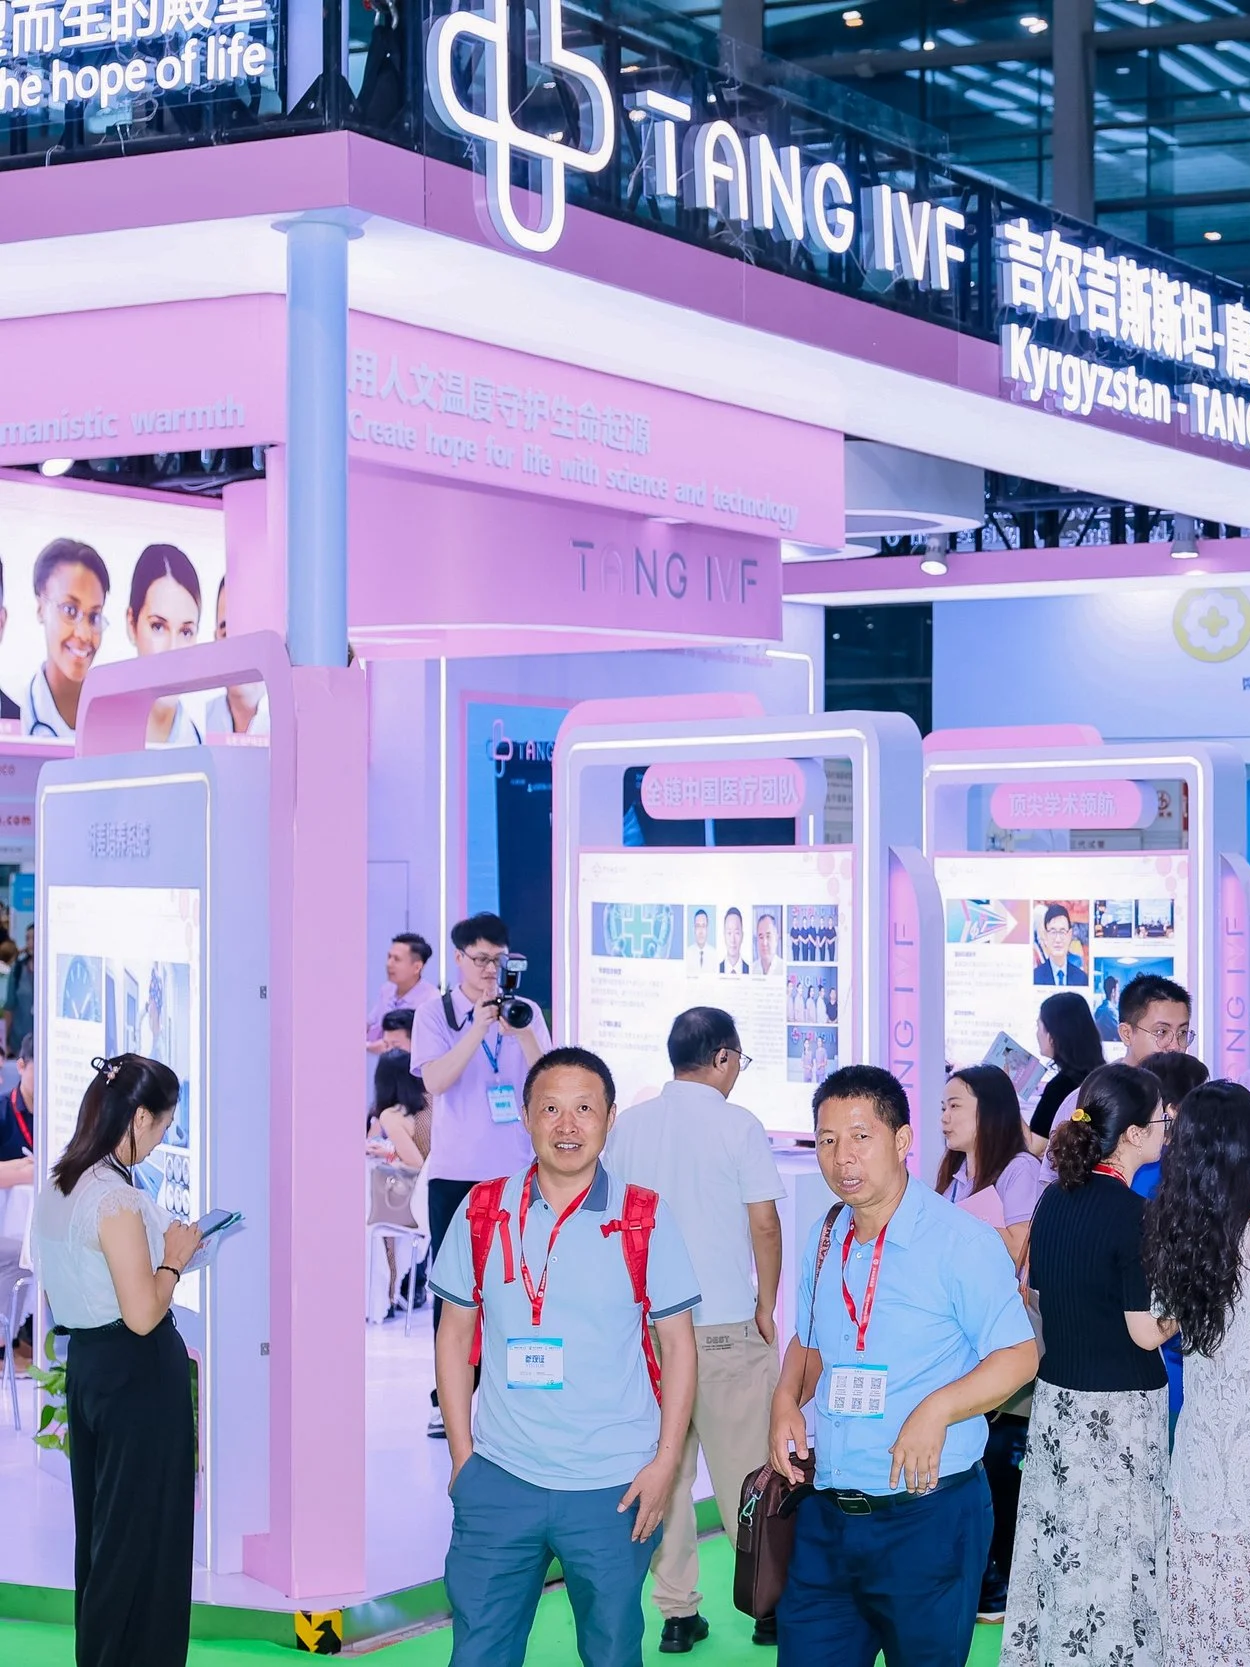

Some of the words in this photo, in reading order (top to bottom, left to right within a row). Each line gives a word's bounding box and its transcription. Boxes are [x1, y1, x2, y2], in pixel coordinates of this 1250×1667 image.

[51, 57, 148, 109] hope
[155, 37, 198, 90] of
[206, 31, 267, 81] life
[644, 88, 856, 254] TANG
[872, 183, 967, 291] IVF
[347, 350, 652, 456] 用人文温度守护生命起源
[1009, 322, 1172, 425] Kyrgyzstan
[0, 407, 118, 447] manistic
[131, 396, 245, 435] warmth
[348, 409, 417, 451] Create
[426, 423, 477, 469] hope
[486, 434, 514, 469] for
[522, 443, 551, 477] life
[560, 453, 599, 487] with
[605, 464, 669, 499] science
[675, 480, 707, 507] and
[713, 484, 799, 532] technology
[569, 535, 688, 600] TANG
[704, 555, 759, 604] IVF
[645, 775, 800, 807] 全链中国医疗团队
[1008, 792, 1117, 818] 顶尖学术领航
